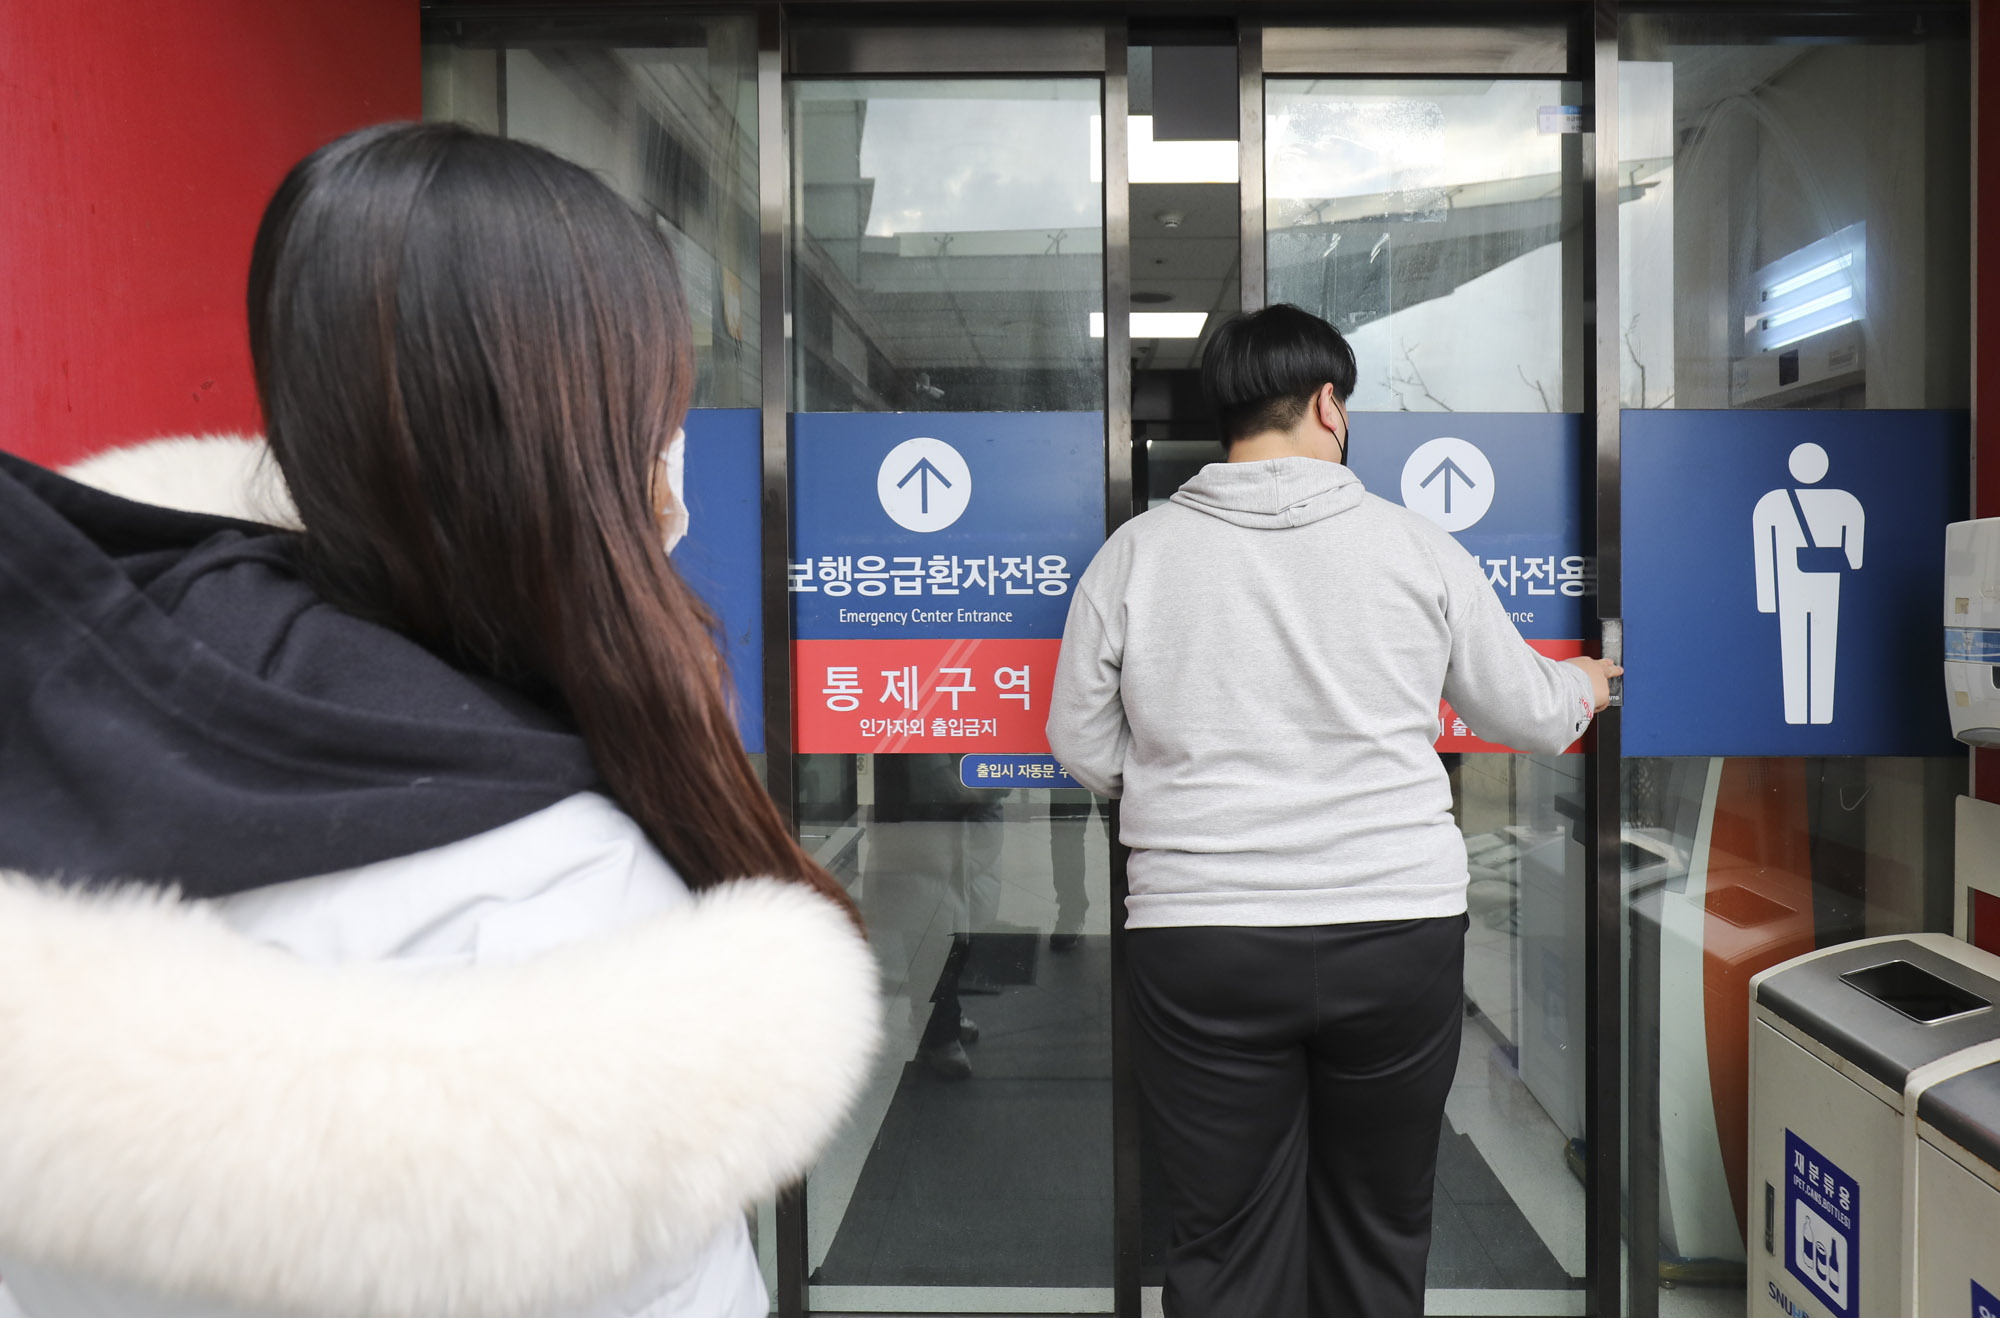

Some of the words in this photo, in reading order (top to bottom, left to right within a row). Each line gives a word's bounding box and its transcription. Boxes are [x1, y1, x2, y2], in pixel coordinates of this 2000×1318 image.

[788, 555, 1071, 597] 보행응급환자전용
[1474, 555, 1586, 597] 자전용
[839, 608, 908, 626] Emergency
[911, 608, 953, 623] Center
[957, 608, 1013, 623] Entrance
[859, 718, 925, 737] 인가자외
[930, 718, 998, 737] 출입금지
[976, 763, 1013, 778] 출입시
[1018, 763, 1055, 778] 자동문
